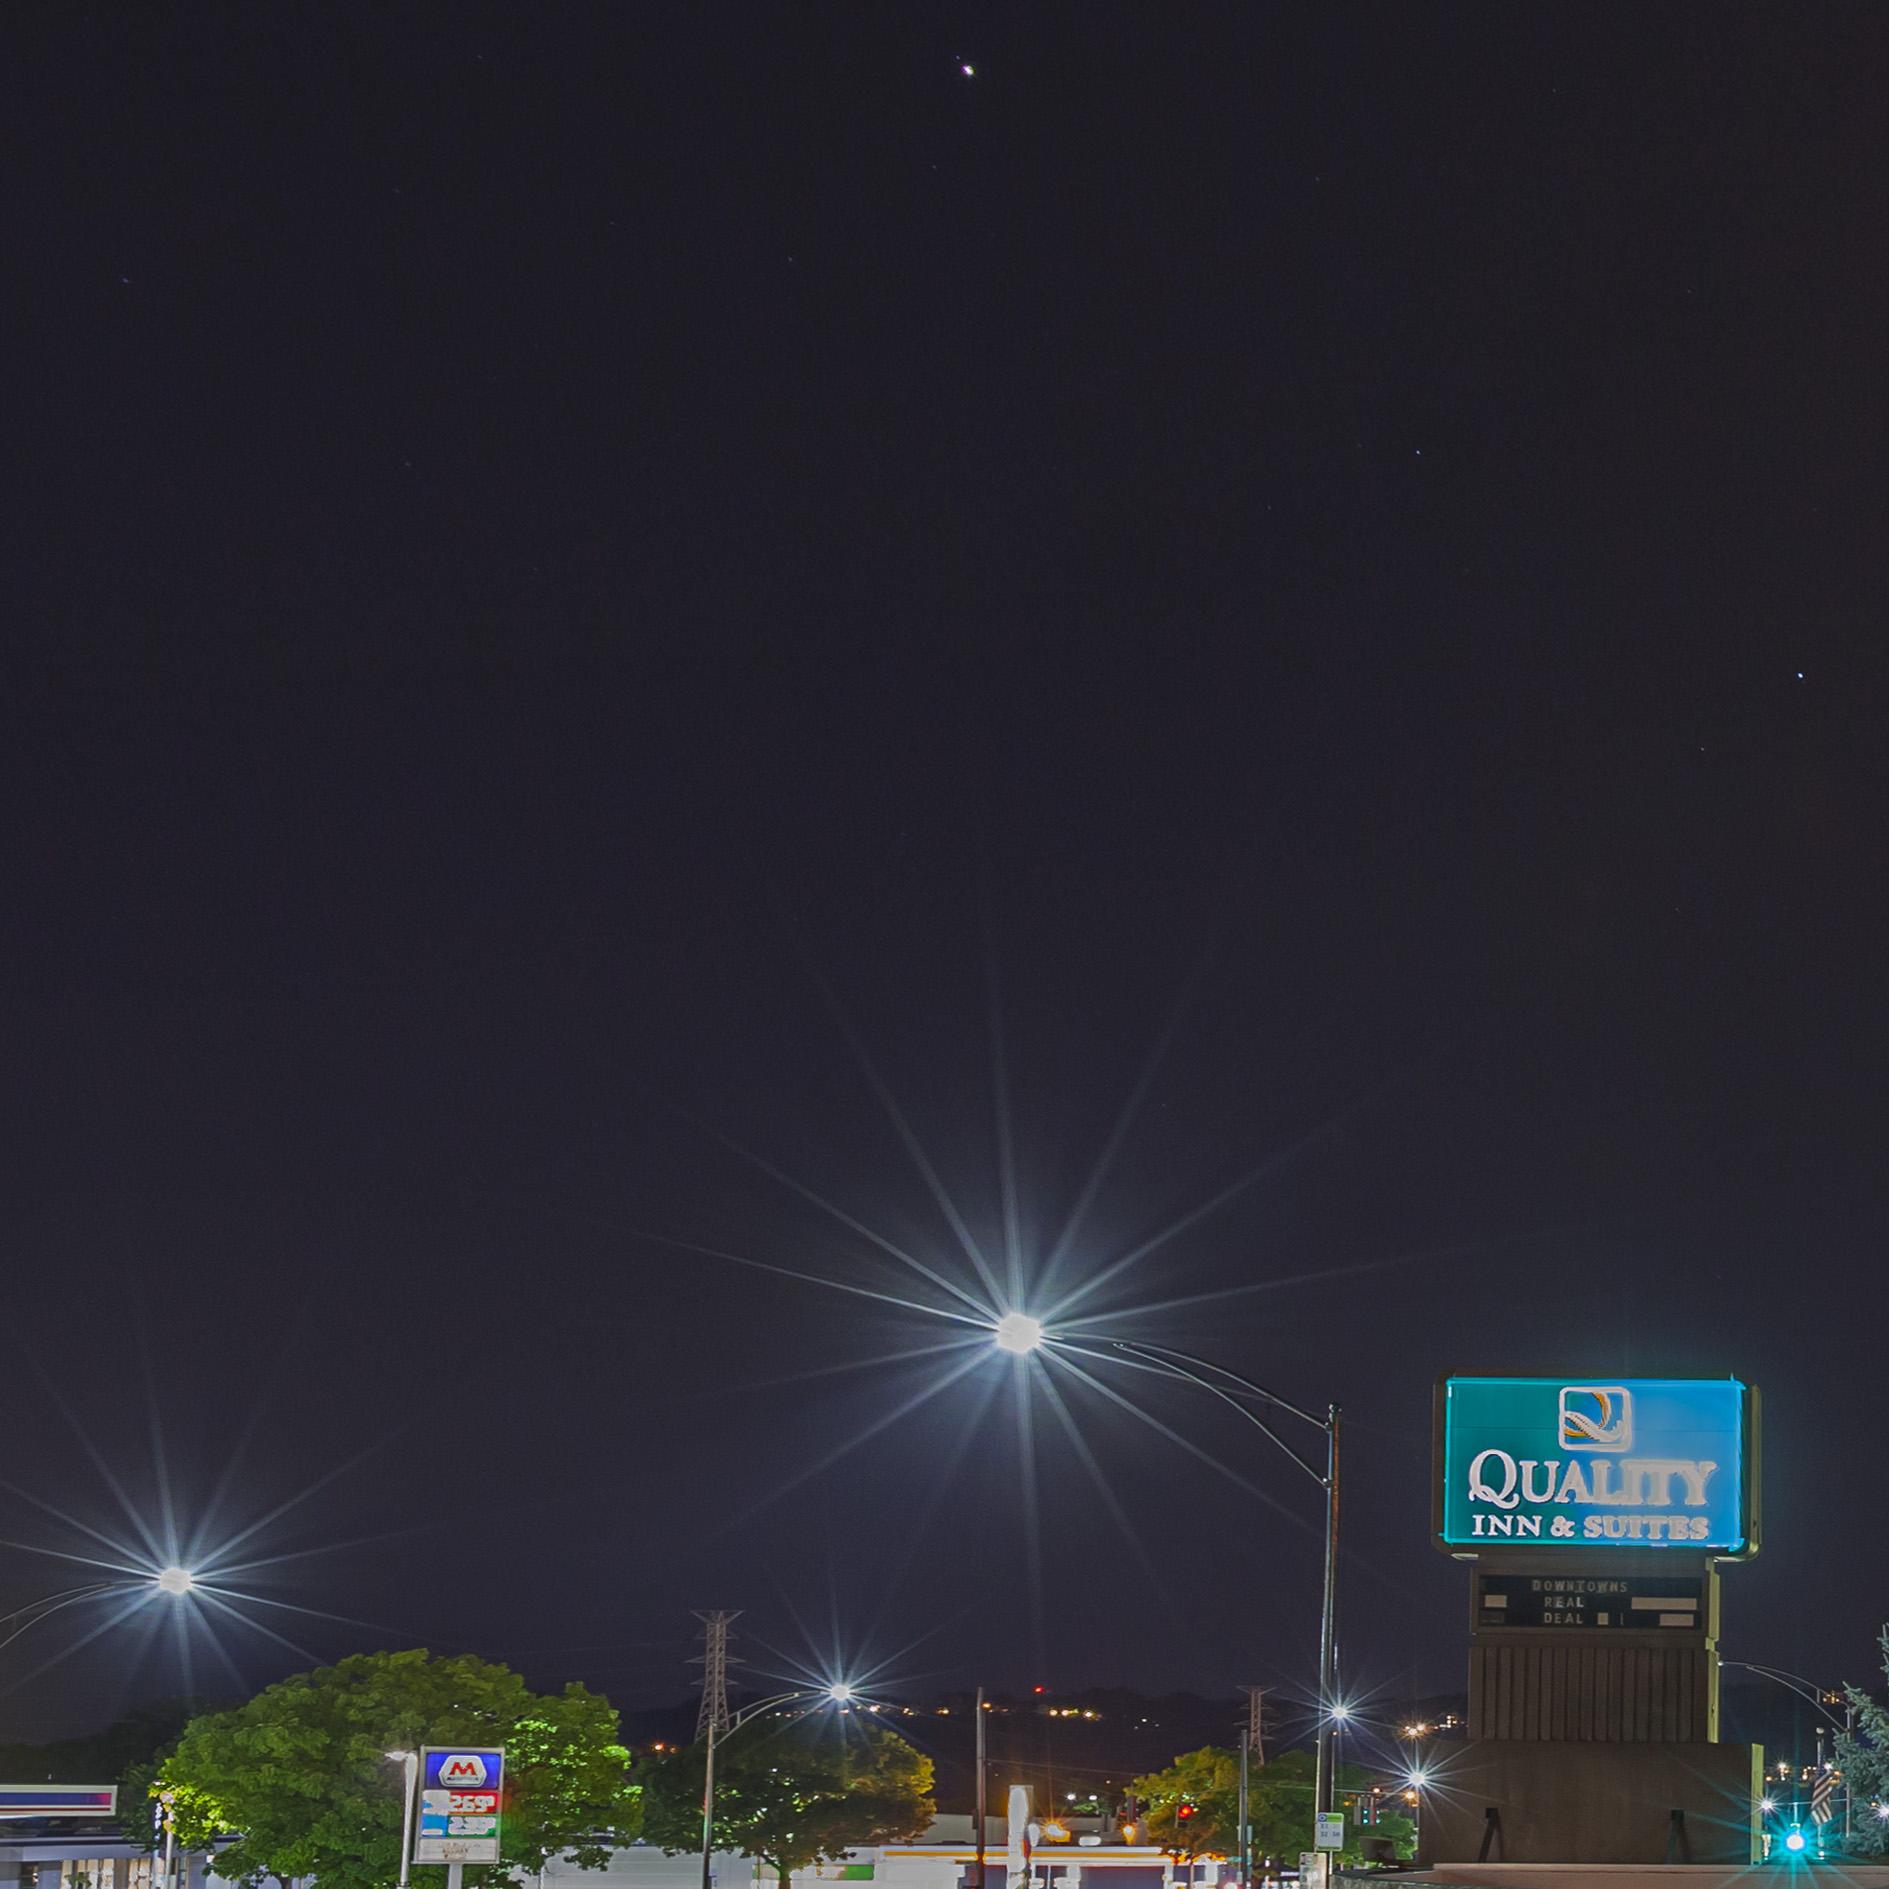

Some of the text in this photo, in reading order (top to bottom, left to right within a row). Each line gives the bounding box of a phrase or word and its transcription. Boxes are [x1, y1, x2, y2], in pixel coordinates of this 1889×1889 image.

[1468, 1449, 1718, 1510] QUALITY
[1471, 1514, 1711, 1540] INN & SUITES
[1532, 1579, 1628, 1593] DOWNTOWNS
[1544, 1595, 1585, 1608] REAL
[1544, 1612, 1583, 1624] DEAL
